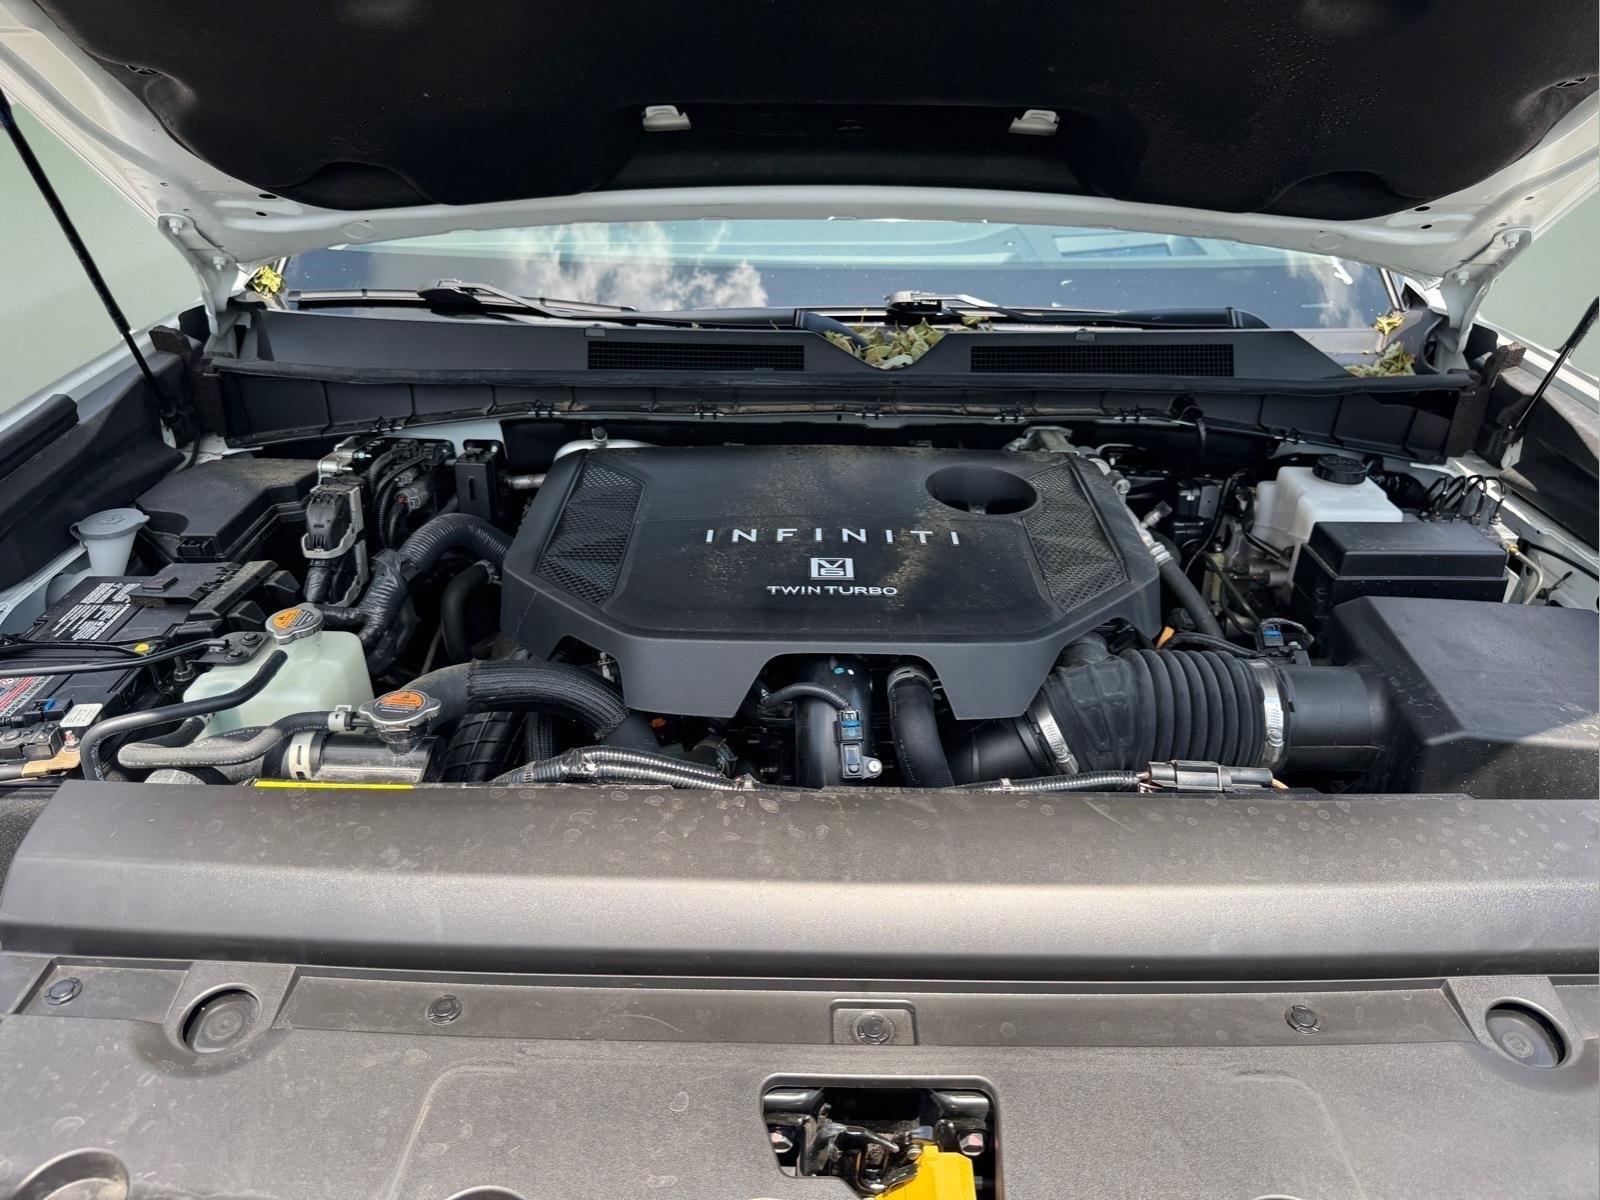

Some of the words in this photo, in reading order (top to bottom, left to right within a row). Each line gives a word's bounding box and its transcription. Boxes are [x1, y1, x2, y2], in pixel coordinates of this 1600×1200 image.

[705, 527, 960, 546] INFINITI
[766, 585, 820, 596] TWIN
[824, 585, 898, 597] TURBO
